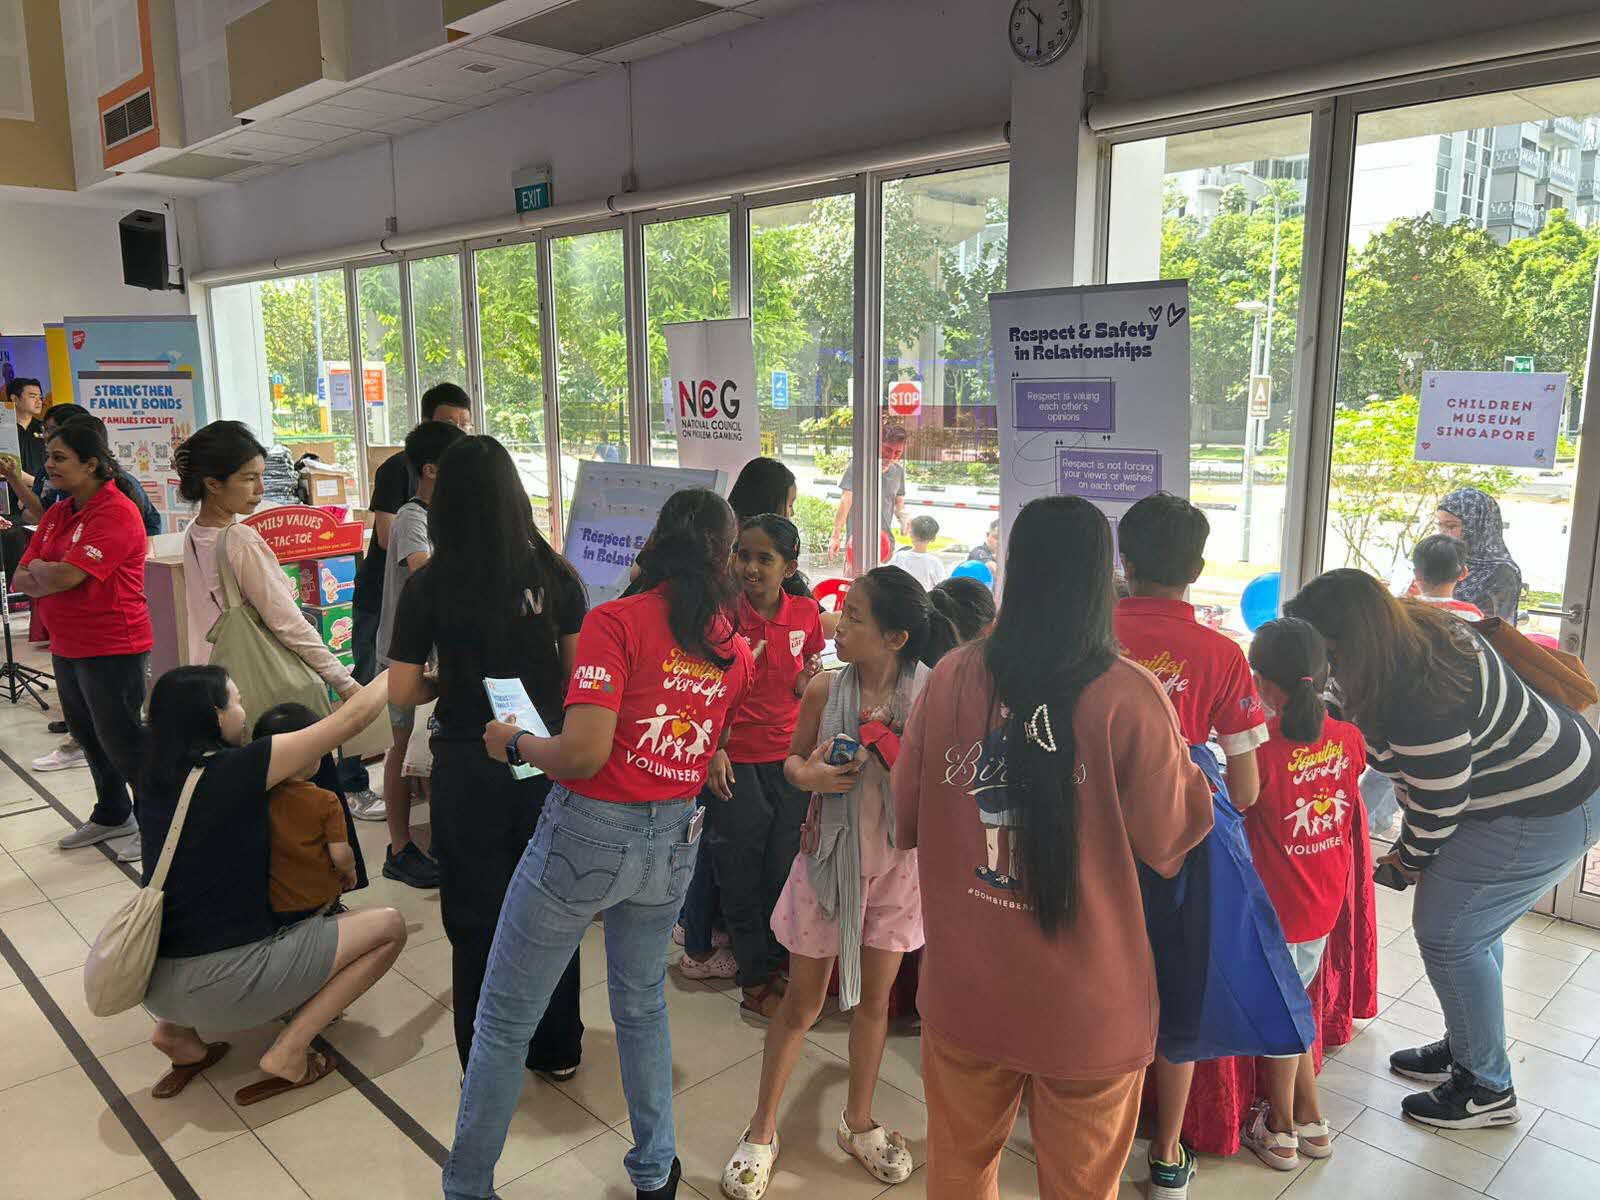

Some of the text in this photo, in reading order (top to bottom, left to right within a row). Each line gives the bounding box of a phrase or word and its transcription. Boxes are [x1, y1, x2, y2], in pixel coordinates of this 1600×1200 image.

[522, 188, 541, 209] EXIT
[1009, 321, 1159, 344] Respect & Safety
[1014, 342, 1152, 361] in Relationships
[94, 384, 173, 397] STRENGTHEN
[1027, 391, 1100, 403] Respect is valuing
[90, 398, 183, 410] FAMILY BONDS
[890, 392, 920, 406] STOP
[1446, 398, 1533, 411] CHILDREN
[1039, 402, 1088, 411] each other's
[101, 416, 175, 425] FAMILIES FOR LIFE
[1047, 412, 1080, 422] opinions
[1453, 413, 1522, 426] MUSEUM
[711, 420, 741, 431] COUNCIL
[682, 429, 691, 437] ON
[1436, 426, 1535, 441] SINGAPORE
[1062, 458, 1154, 474] Respect is not forcing
[1063, 470, 1153, 482] your views or wishes
[1078, 481, 1136, 492] on each other
[286, 514, 323, 530] VALUES
[582, 527, 644, 549] Respect &
[584, 546, 636, 568] in Relati
[1287, 738, 1344, 772] Families
[626, 749, 700, 783] VOLUNTEERS
[1319, 755, 1350, 781] Life
